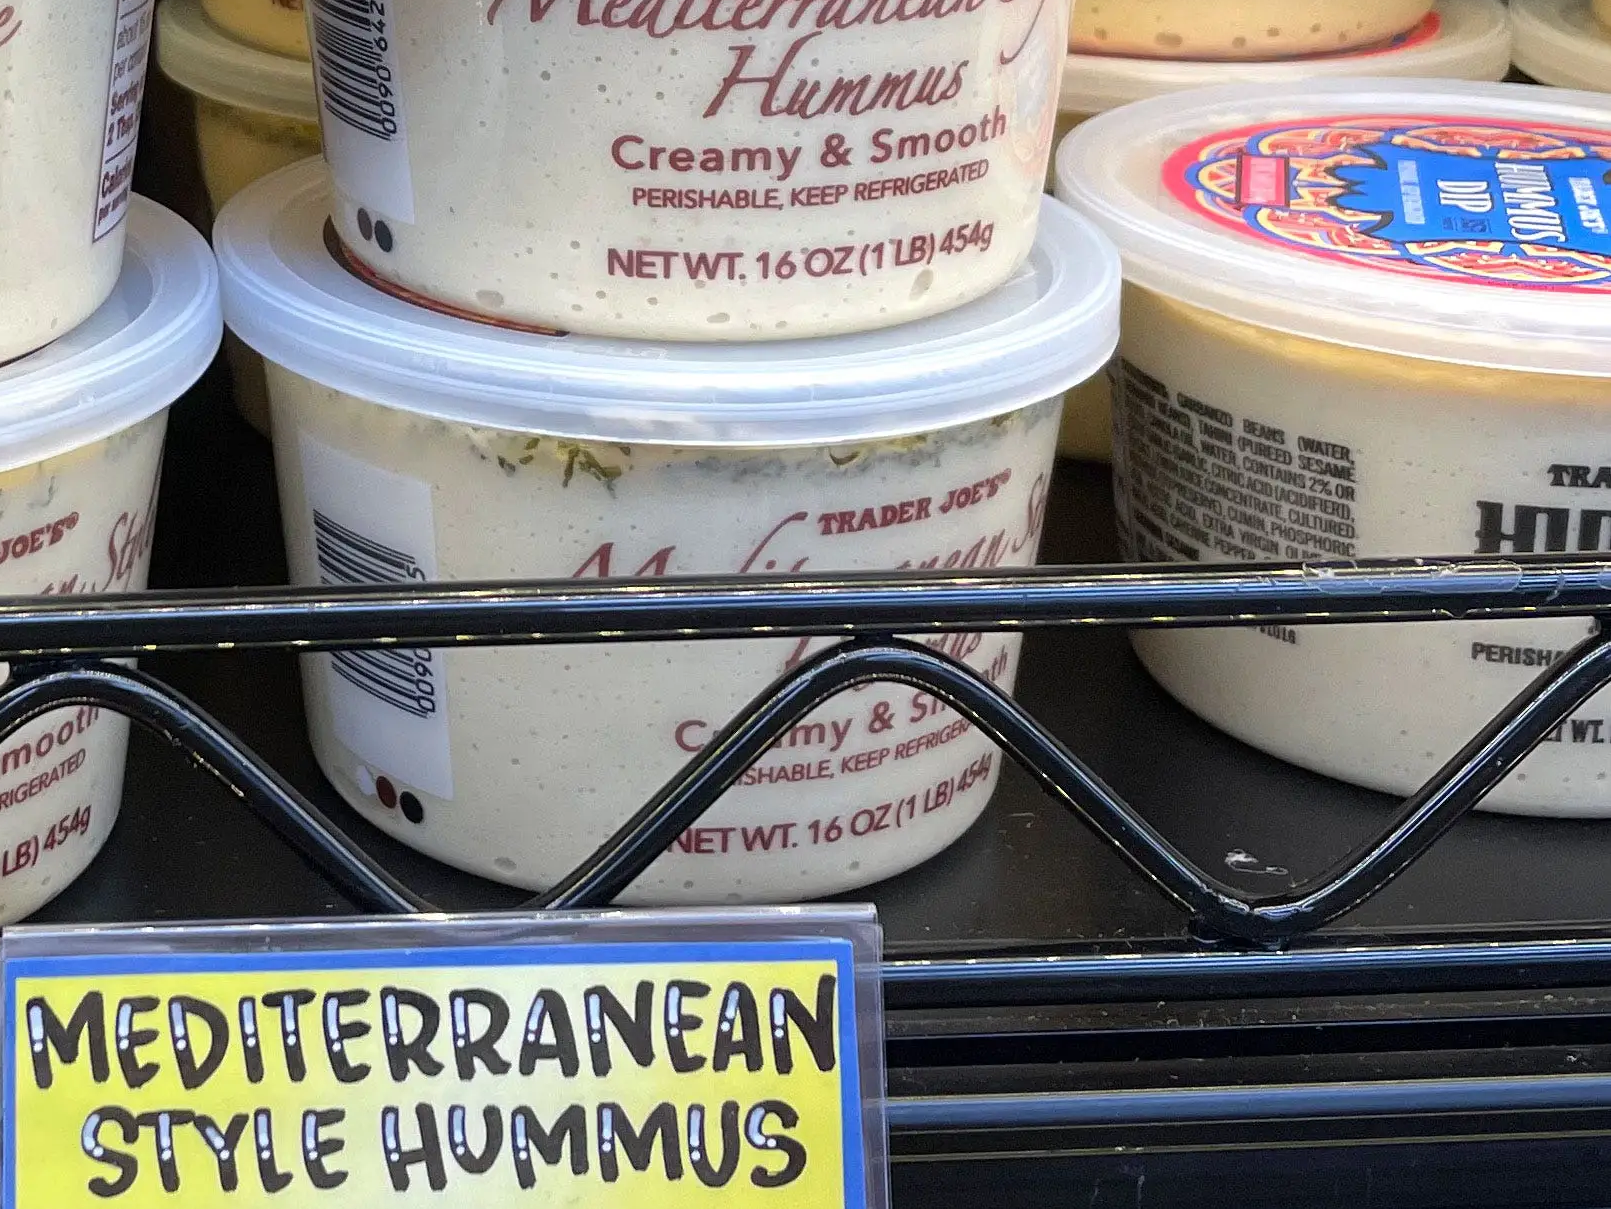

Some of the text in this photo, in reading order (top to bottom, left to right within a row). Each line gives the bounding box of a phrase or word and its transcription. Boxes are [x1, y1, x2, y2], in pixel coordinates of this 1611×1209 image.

[703, 30, 970, 119] Hummus
[611, 105, 1007, 182] Creamy & Smooth
[632, 158, 989, 211] PERISHABLE, KEEP REFRIGERATED
[1437, 179, 1494, 214] DIP
[1495, 162, 1567, 242] HUMMUS
[607, 249, 678, 278] NET
[680, 250, 747, 280] WT.
[755, 250, 797, 279] 16
[1243, 456, 1356, 502] CONTAINS 2% OR
[1298, 454, 1356, 483] SESAME
[1547, 464, 1611, 487] TRA
[818, 497, 932, 537] TRADER
[1288, 507, 1356, 540] CULTURED
[1270, 521, 1356, 557] PHOSPHORIC
[868, 701, 896, 734] &
[841, 747, 890, 774] KEEP
[807, 815, 842, 845] 16
[26, 974, 837, 1090] MEDITERRANEAN
[80, 1099, 808, 1198] STYLE HUMMUS
